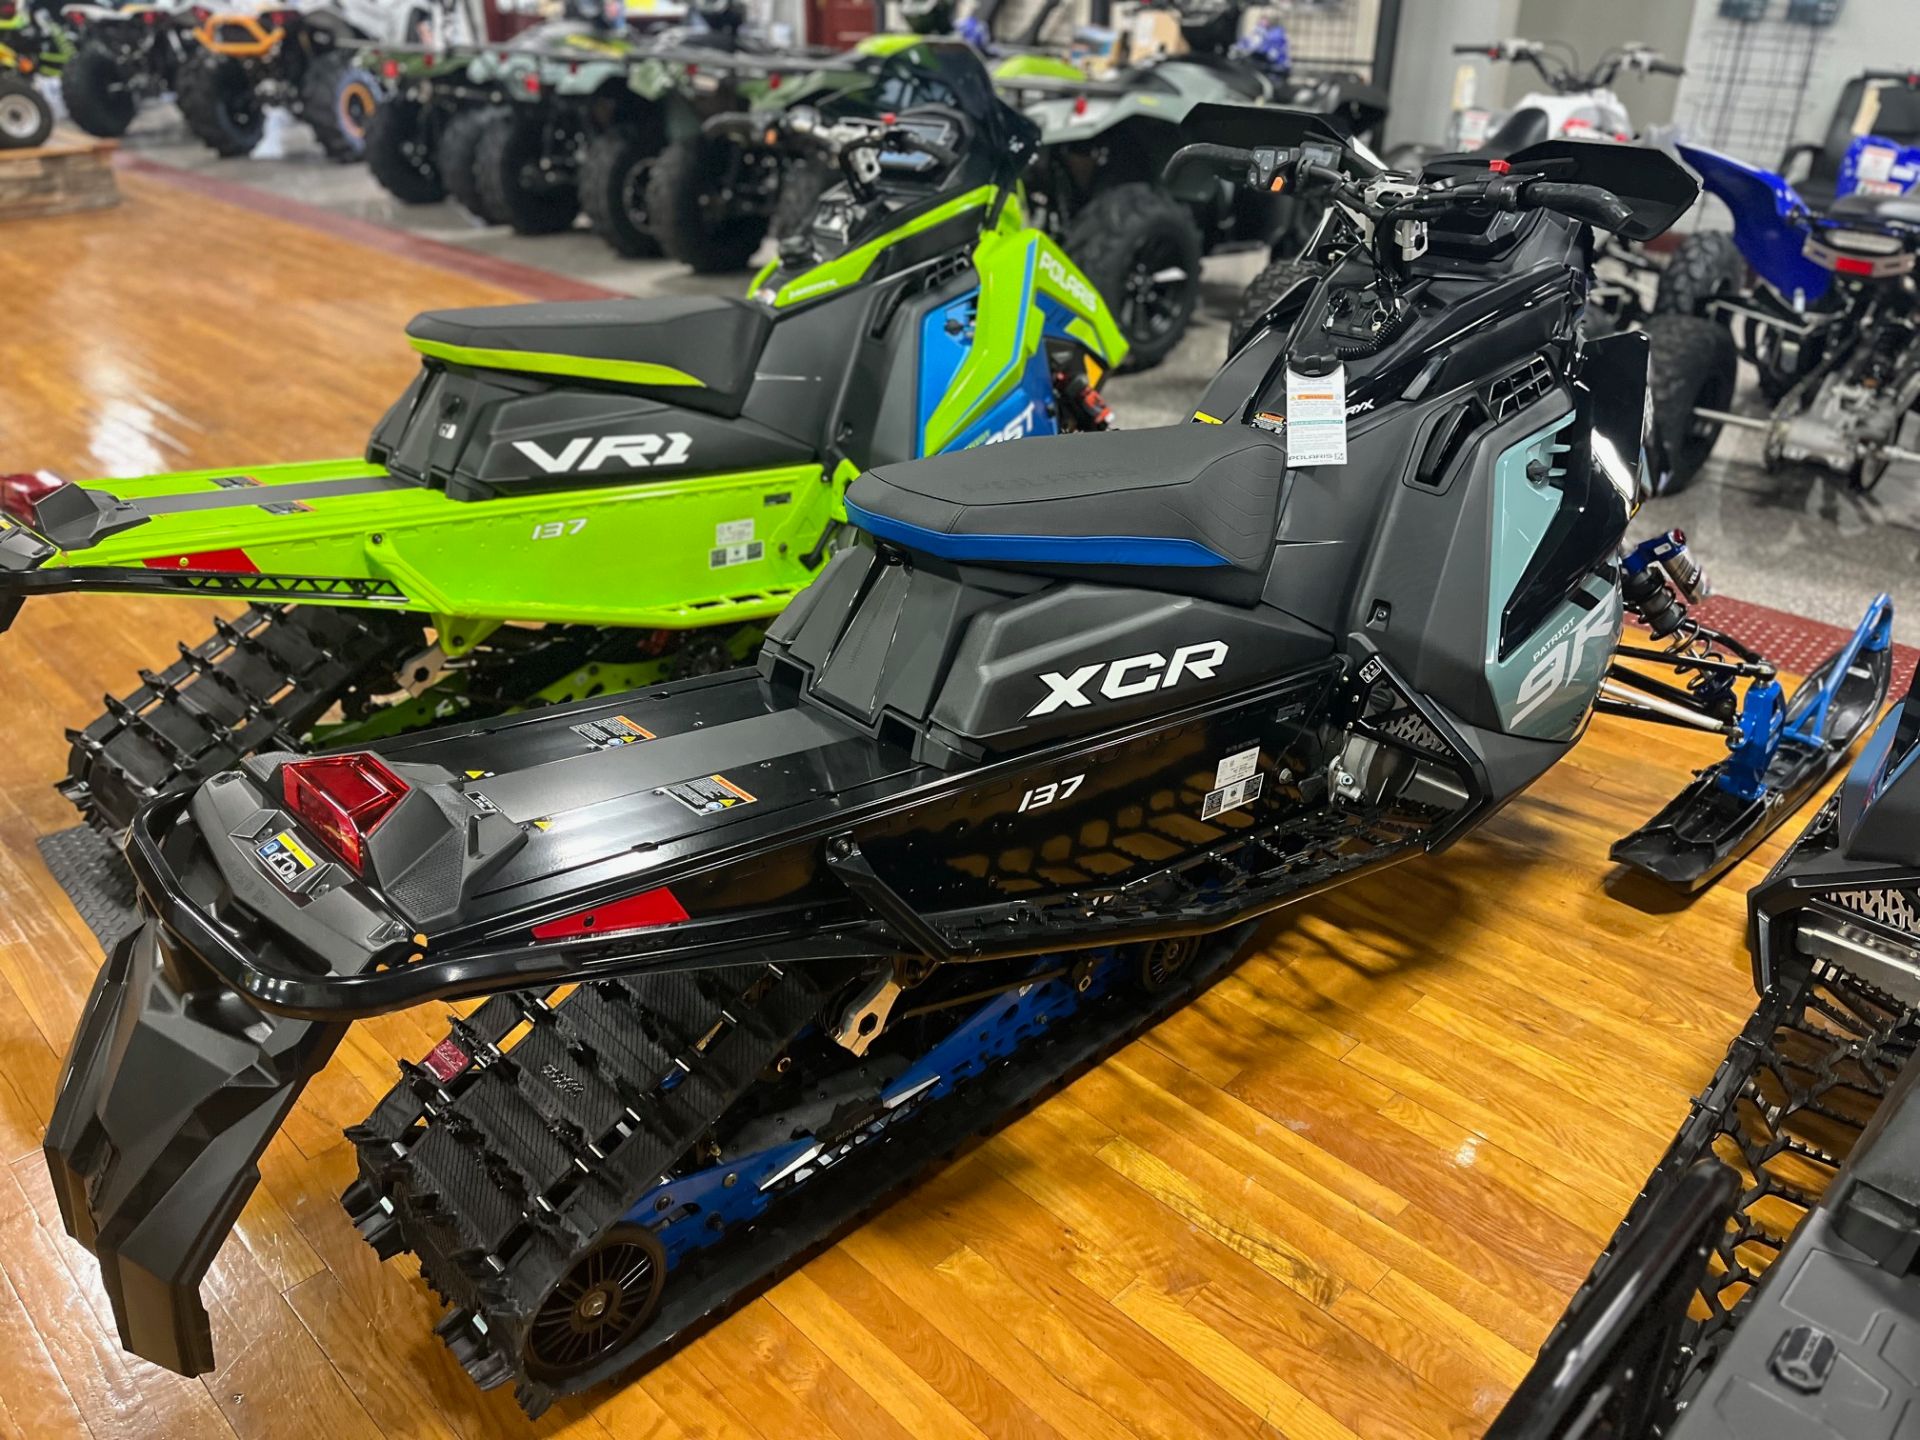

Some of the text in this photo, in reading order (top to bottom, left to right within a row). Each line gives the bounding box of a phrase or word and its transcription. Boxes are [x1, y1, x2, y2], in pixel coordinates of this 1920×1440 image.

[1039, 250, 1097, 312] POLARIS
[1346, 399, 1374, 416] RYX
[512, 432, 693, 473] VR1
[1289, 453, 1333, 461] POLARIS
[531, 518, 588, 541] 137
[1509, 584, 1617, 730] 9R
[1533, 616, 1575, 662] PATRIOT
[1025, 640, 1229, 718] XCR
[1017, 773, 1086, 813] 137
[835, 1113, 876, 1143] POLARIS
